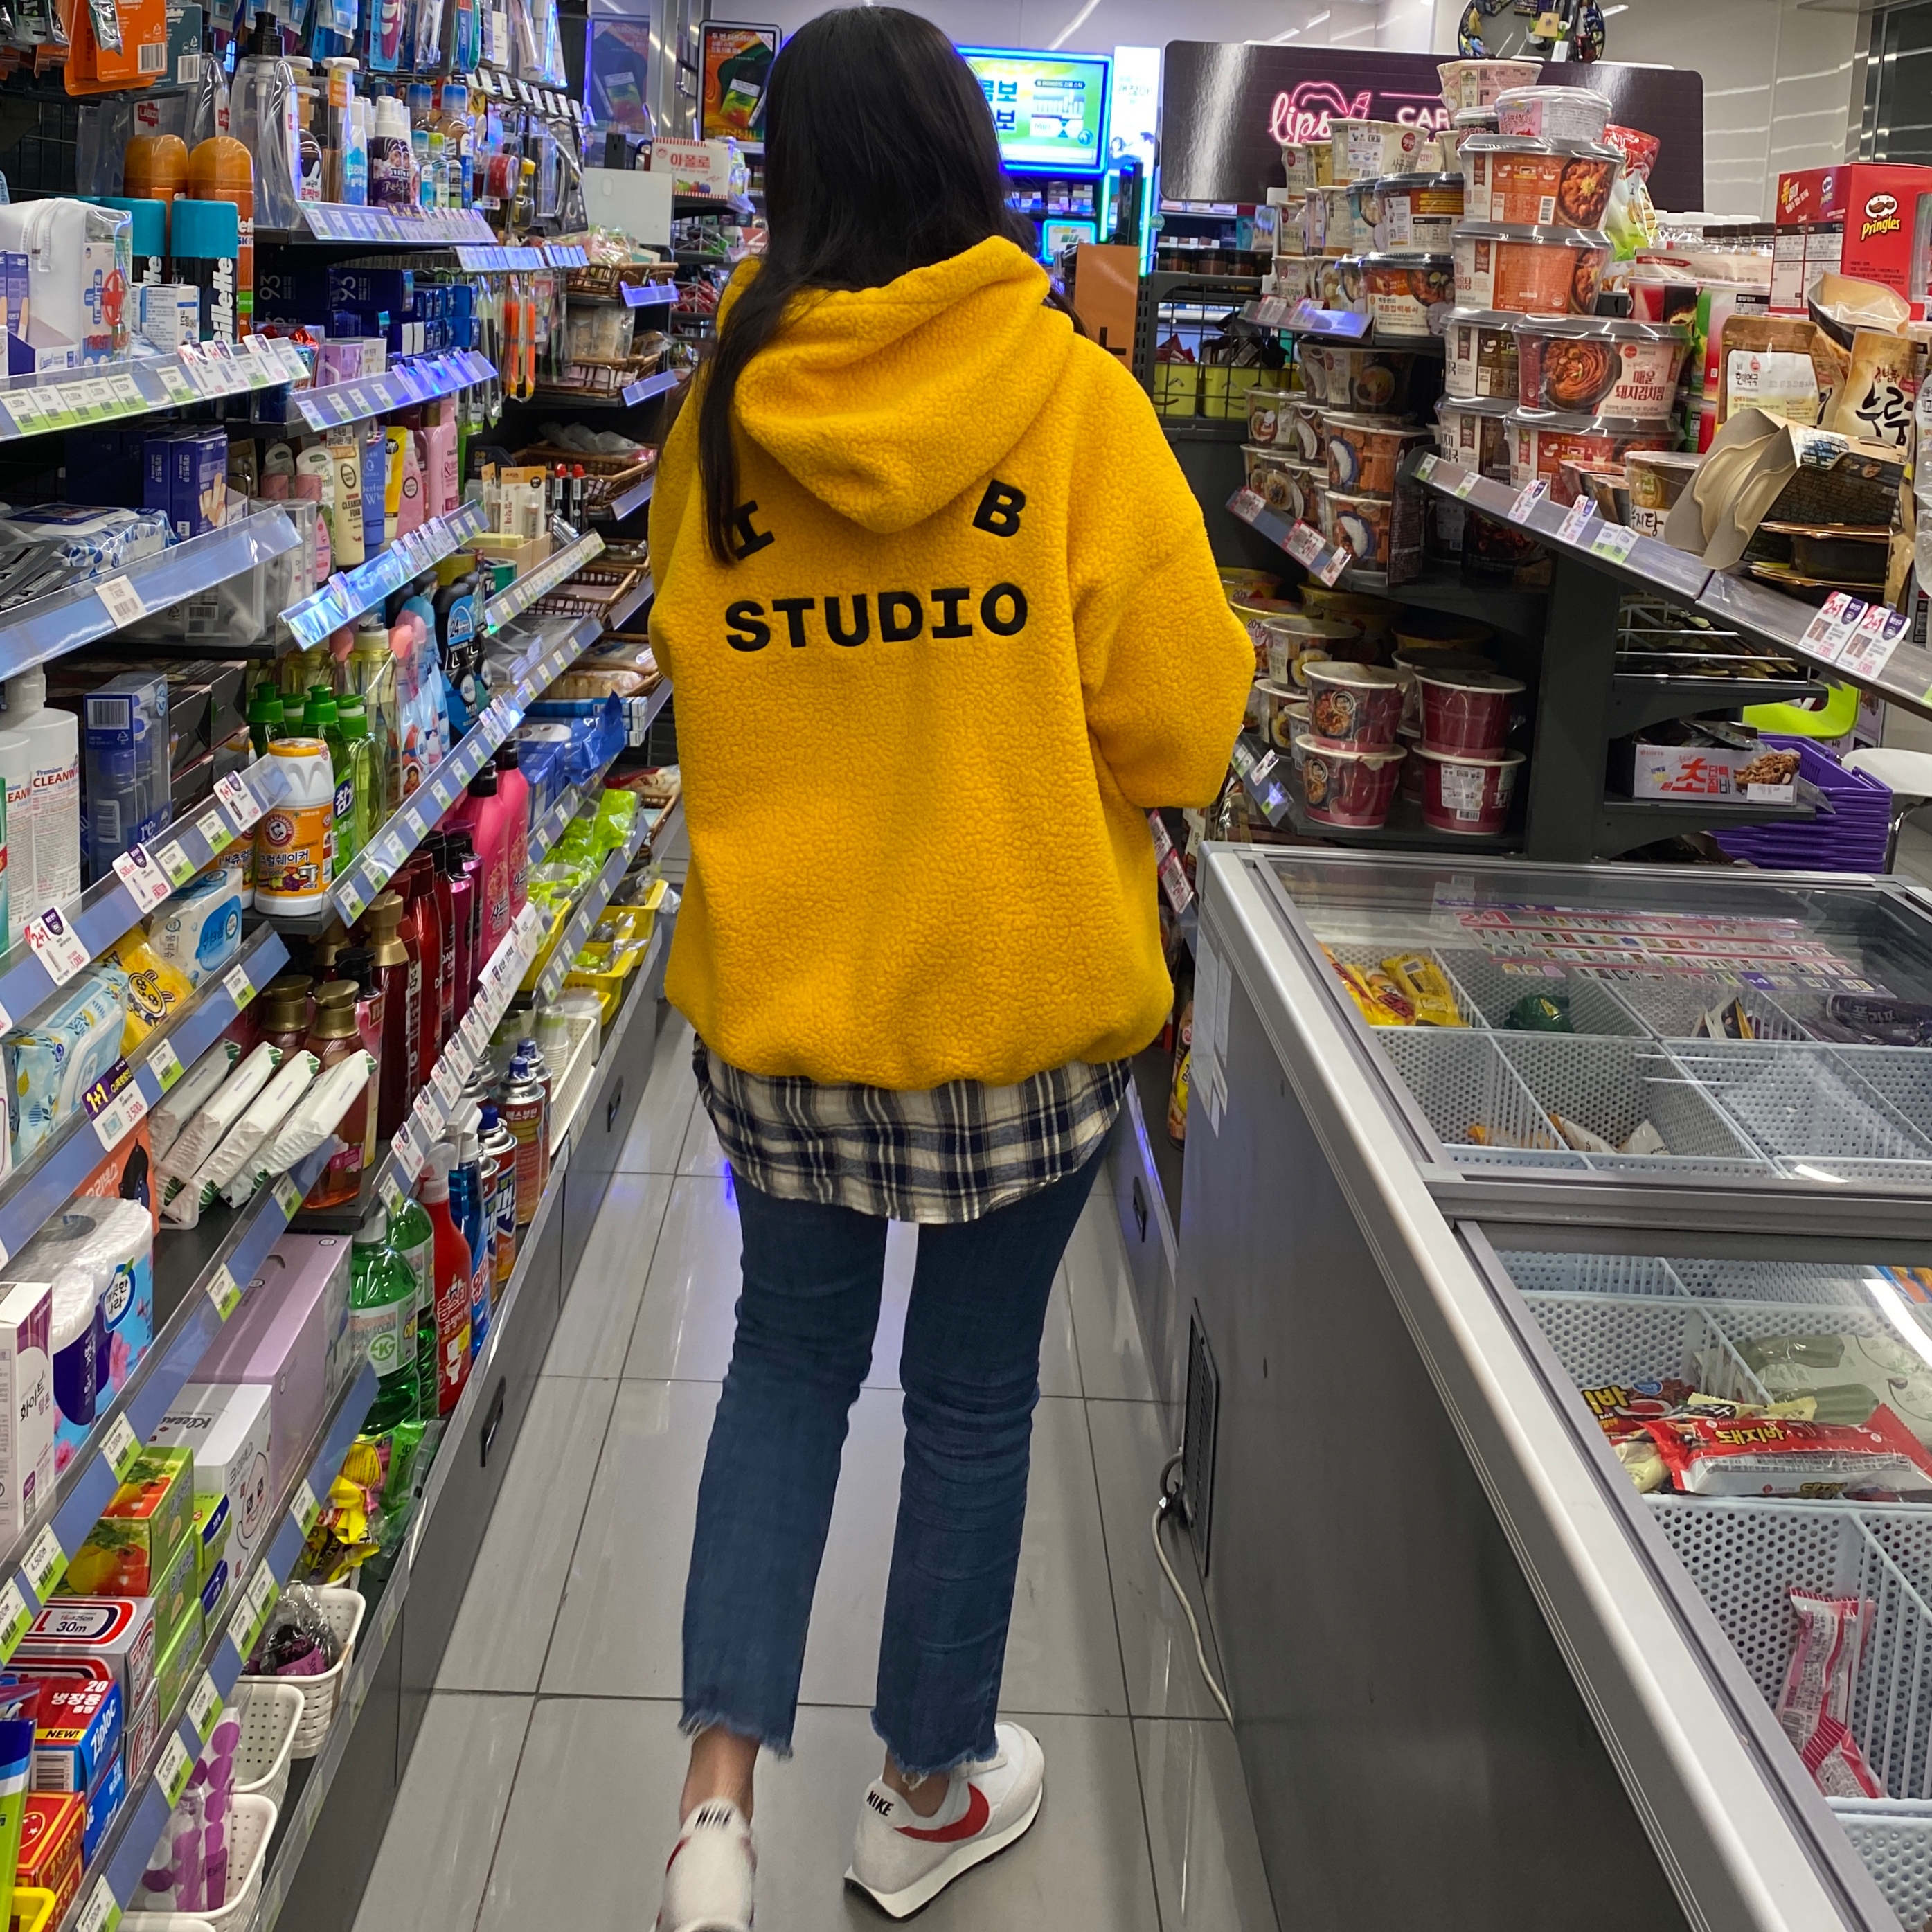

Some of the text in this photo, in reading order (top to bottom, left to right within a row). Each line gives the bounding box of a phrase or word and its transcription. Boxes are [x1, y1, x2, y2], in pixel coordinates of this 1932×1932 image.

[1270, 92, 1332, 143] lips
[670, 153, 710, 169] 아폴로
[1861, 218, 1902, 241] Pringles
[1633, 370, 1656, 385] 매운
[1615, 385, 1665, 401] 돼지김치찜
[972, 479, 1026, 537] B
[724, 582, 1028, 652] STUDIO
[450, 619, 463, 638] 24
[1255, 629, 1267, 638] UP
[36, 767, 63, 777] Premium
[1658, 758, 1708, 793] 초
[1454, 910, 1512, 925] 2+1
[30, 926, 51, 949] 2+1
[86, 1082, 109, 1113] 1+1
[20, 1369, 46, 1422] 화이트
[1712, 1426, 1785, 1448] 돼지바
[55, 1622, 87, 1633] 30m
[84, 1680, 107, 1692] 20
[51, 1692, 102, 1706] 냉장용
[45, 1729, 80, 1739] NEW!
[90, 1699, 118, 1764] Ziploc
[866, 1789, 895, 1818] NIKE
